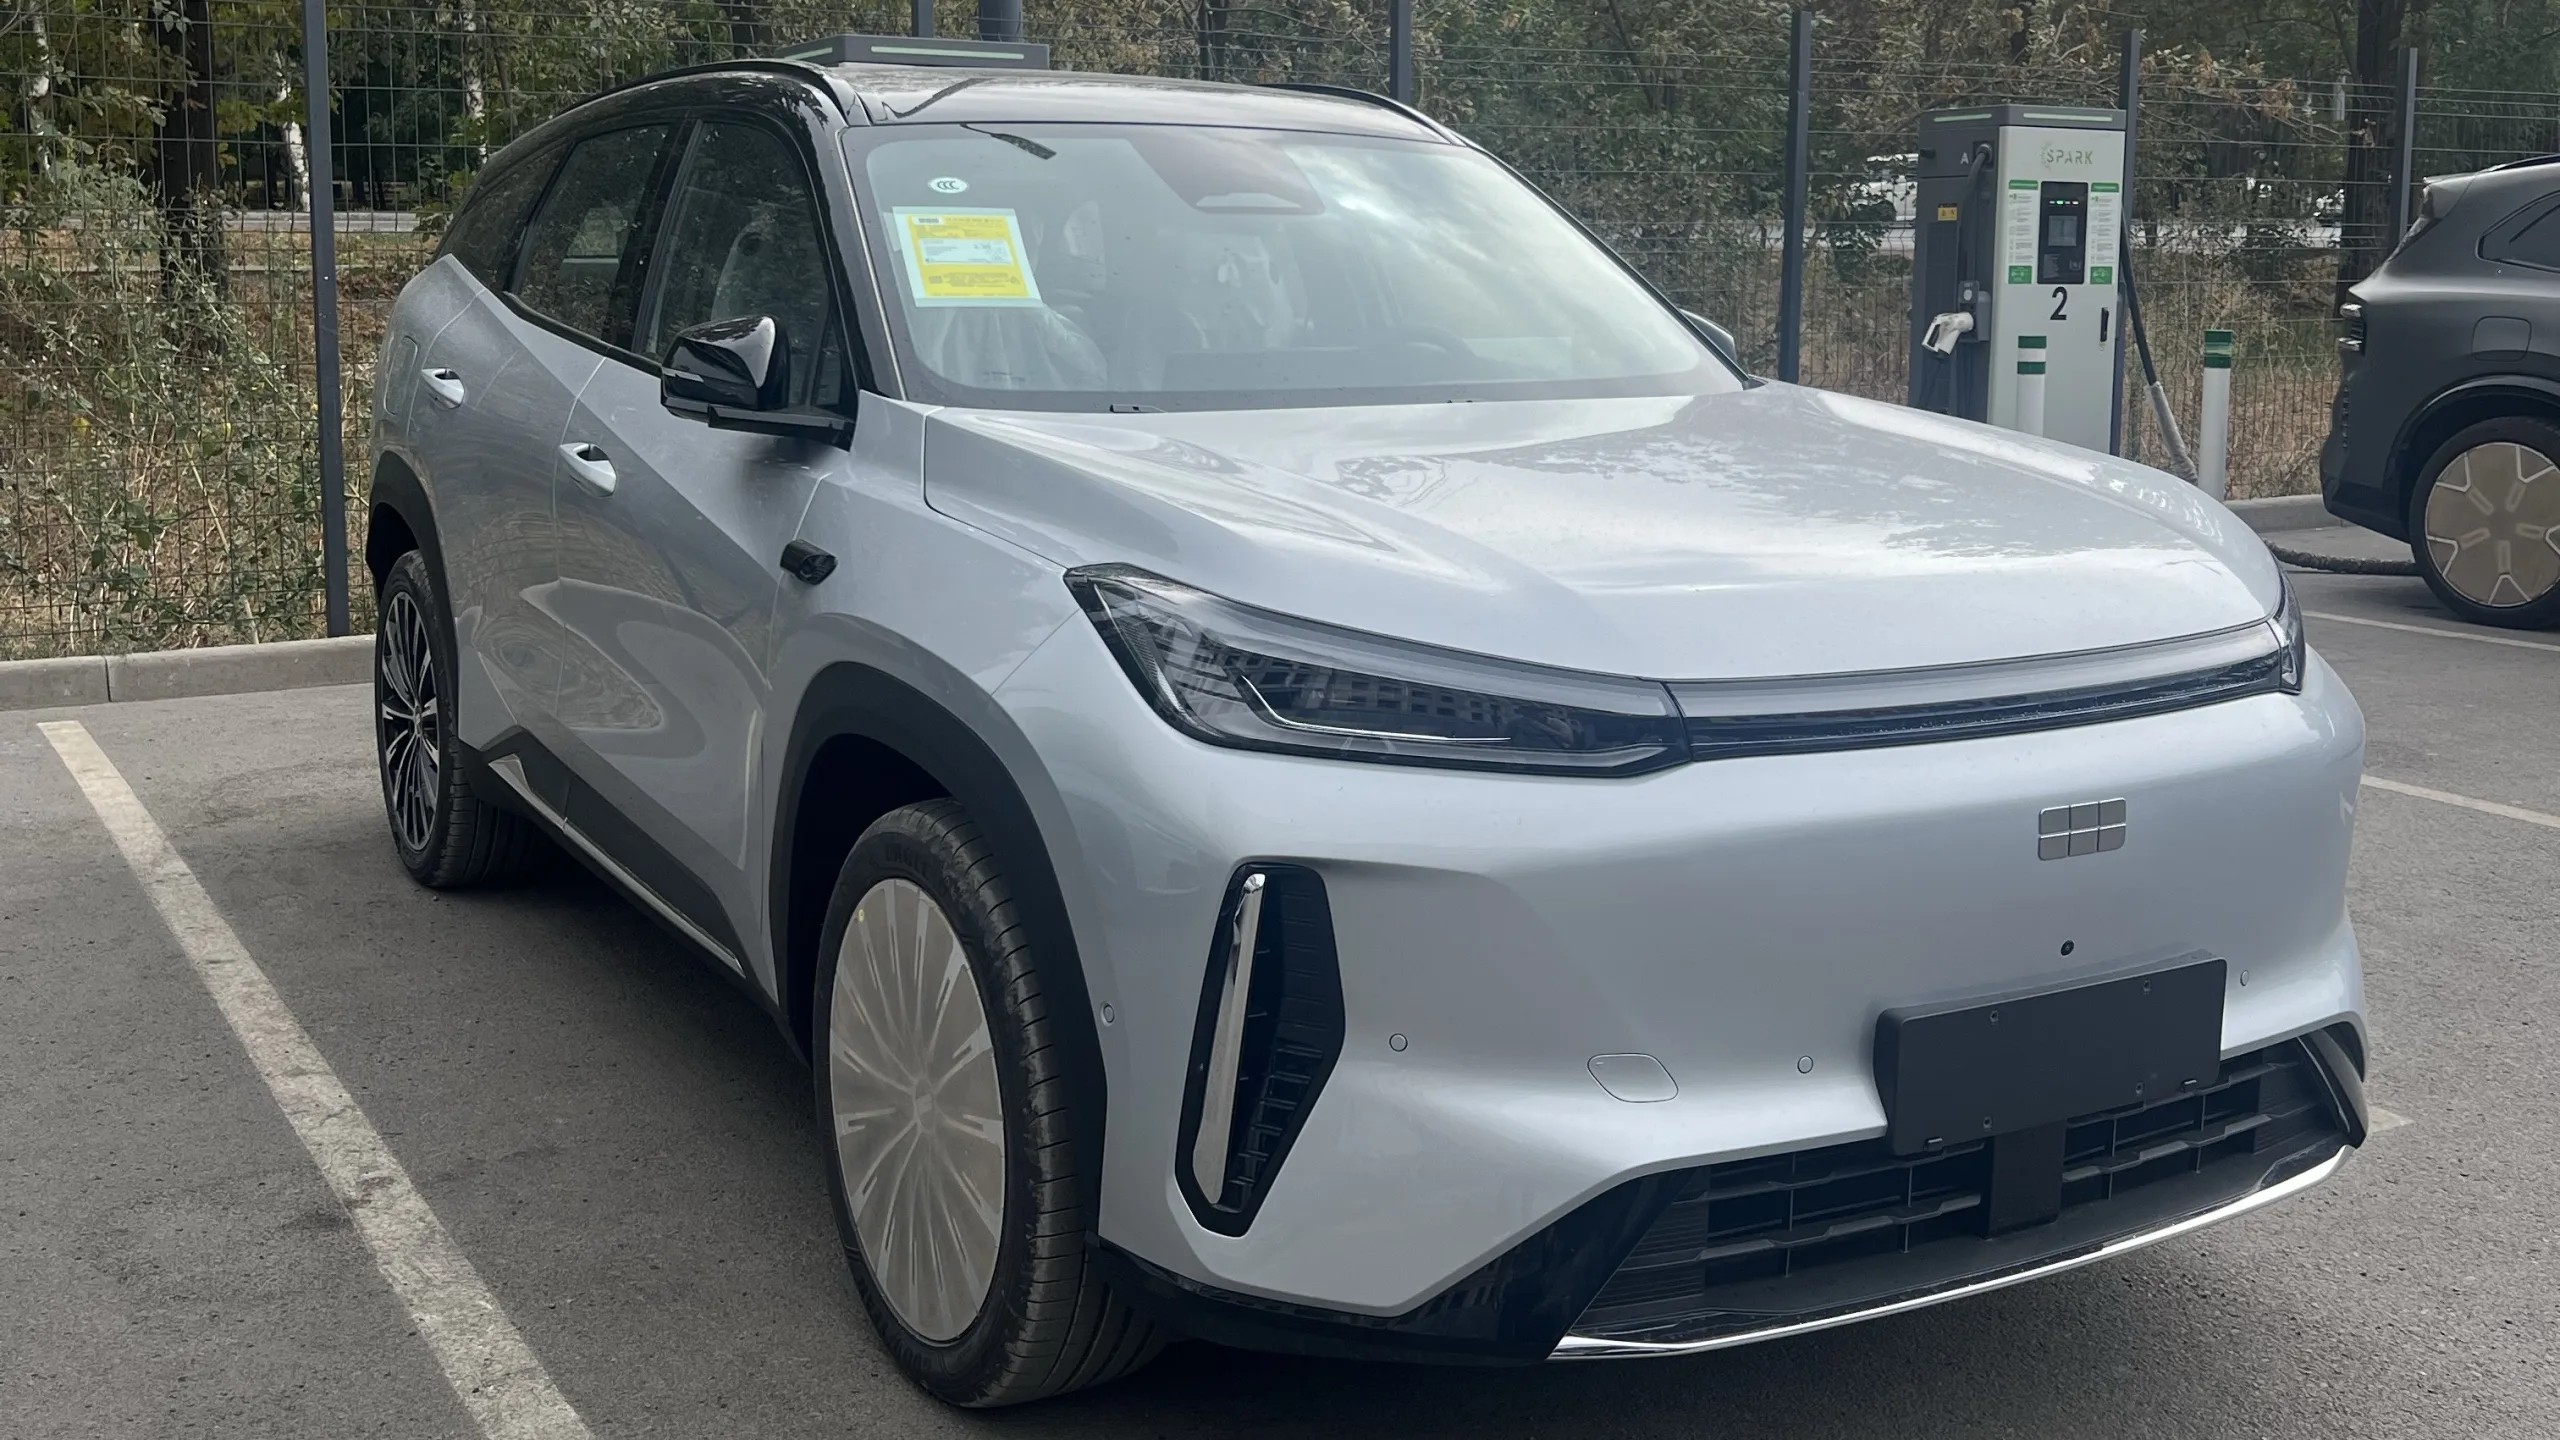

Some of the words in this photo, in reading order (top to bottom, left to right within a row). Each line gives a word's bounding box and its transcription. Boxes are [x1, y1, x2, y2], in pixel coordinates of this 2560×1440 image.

[1960, 152, 1969, 165] A
[2046, 149, 2093, 165] SPARK
[2050, 286, 2068, 321] 2
